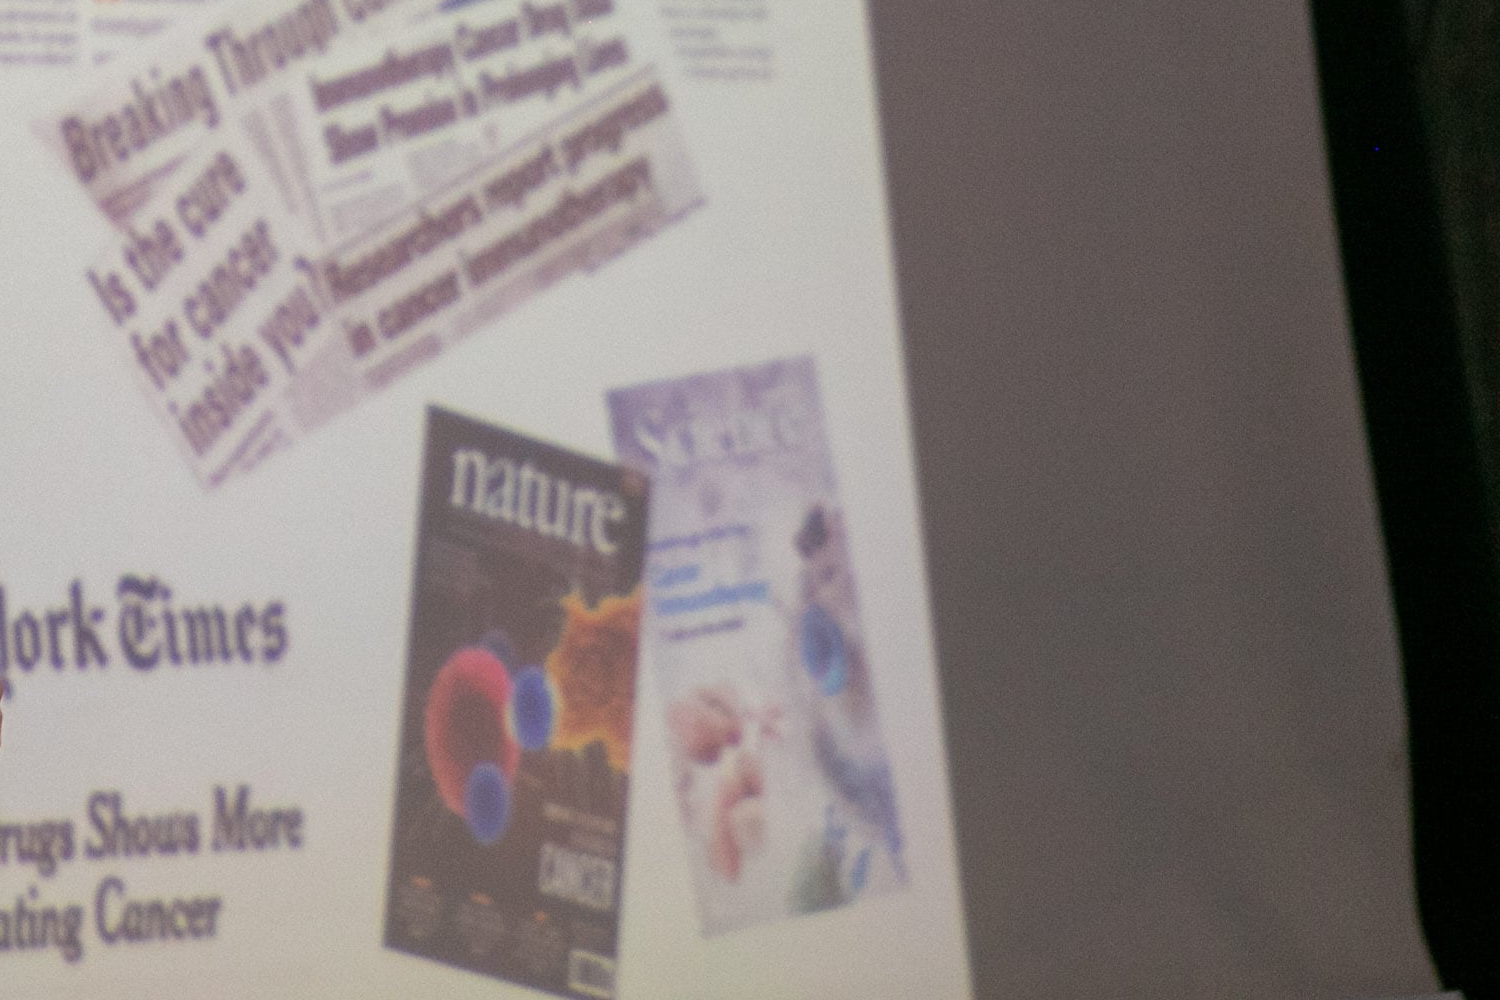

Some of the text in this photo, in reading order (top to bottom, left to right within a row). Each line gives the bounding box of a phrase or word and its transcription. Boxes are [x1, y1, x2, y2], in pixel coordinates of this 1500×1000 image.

[62, 64, 221, 184] Breaking
[86, 152, 246, 327] Is the cure
[130, 318, 191, 391] for
[184, 219, 279, 340] cancer
[167, 344, 270, 456] inside
[449, 446, 628, 557] nature
[116, 573, 290, 672] Times
[84, 789, 200, 861] Shows
[211, 783, 306, 854] More
[94, 874, 223, 946] Cancer
